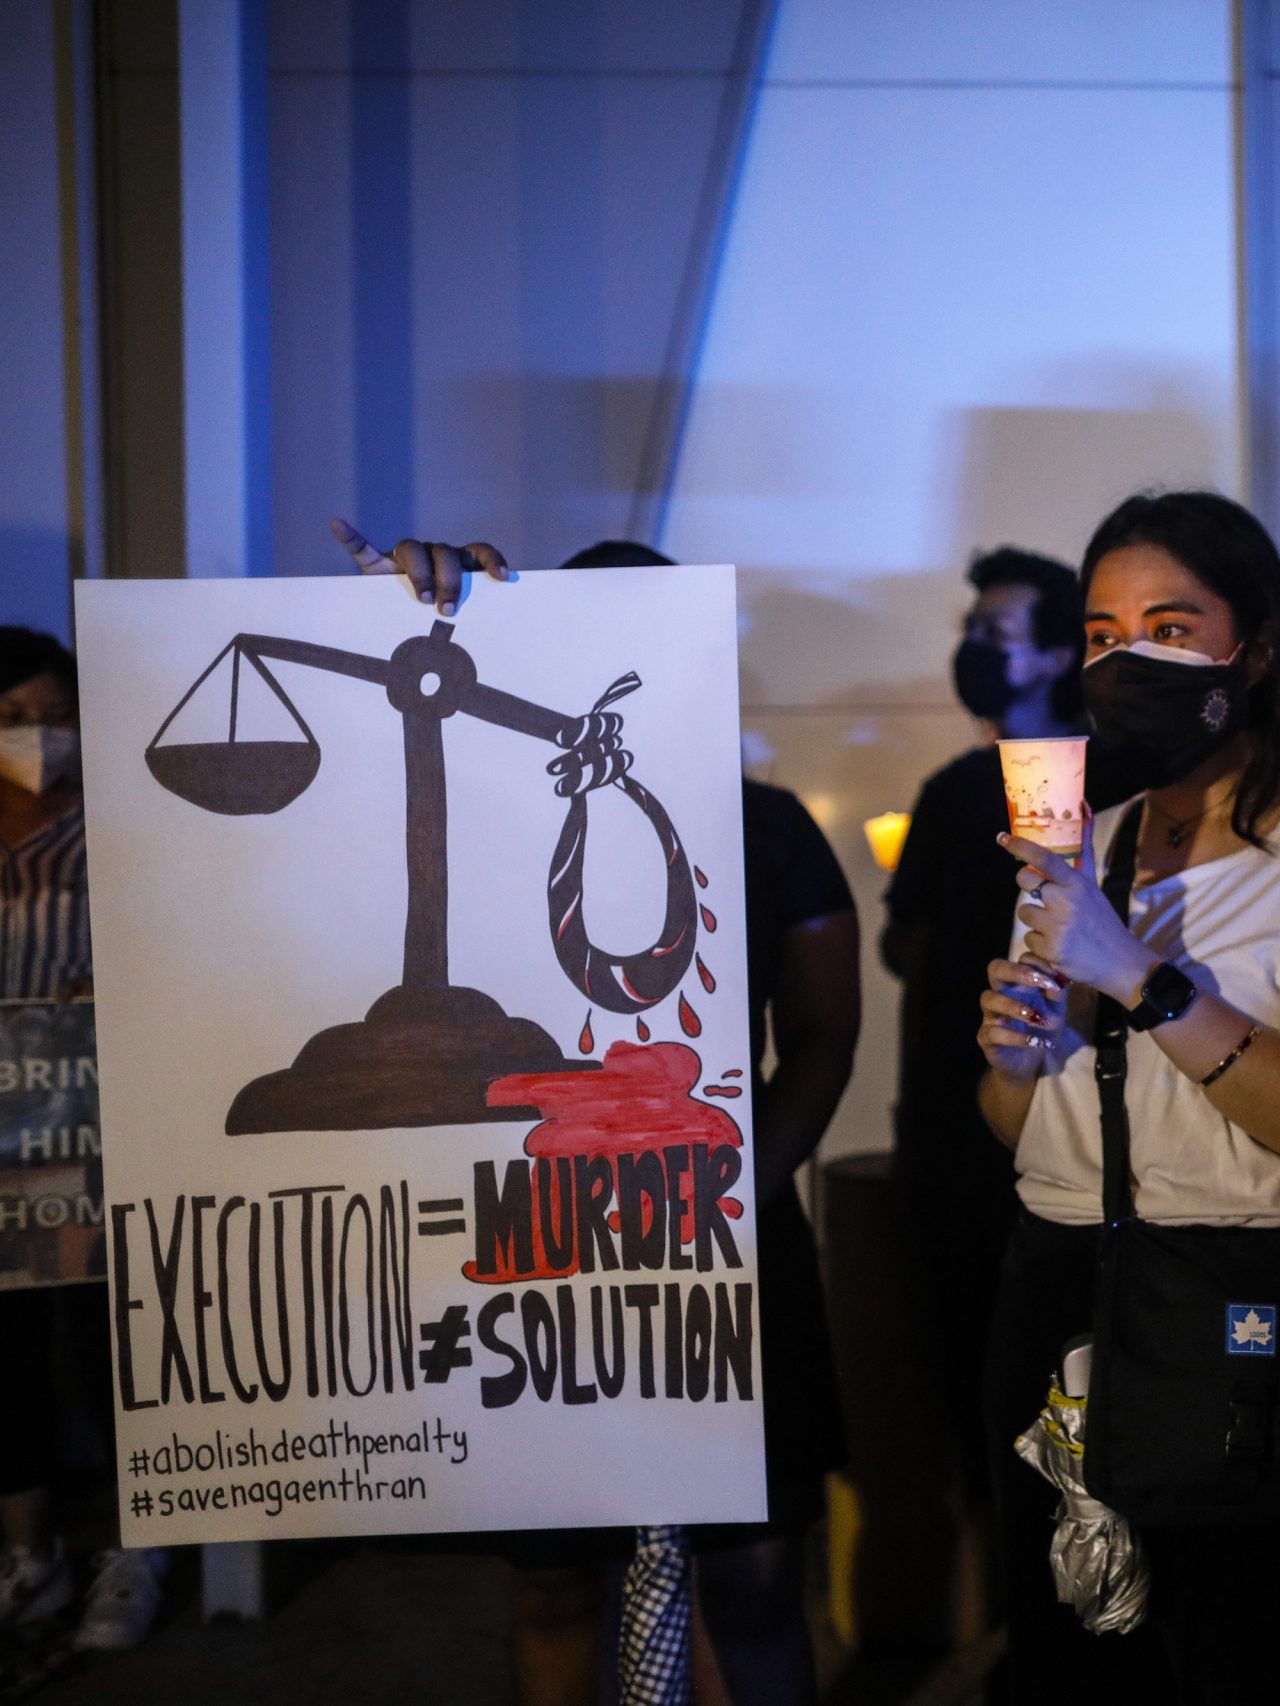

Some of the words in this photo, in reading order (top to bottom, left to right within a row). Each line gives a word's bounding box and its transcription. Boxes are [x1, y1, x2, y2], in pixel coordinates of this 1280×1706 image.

[0, 1055, 98, 1094] BRIN
[0, 1195, 105, 1231] HOM
[111, 1179, 415, 1411] EXECUTION
[473, 1143, 744, 1276] MURDER
[476, 1282, 754, 1409] SOLUTION
[127, 1417, 469, 1478] #abolishdeathpenalty
[130, 1471, 427, 1518] #savenagaenthran
